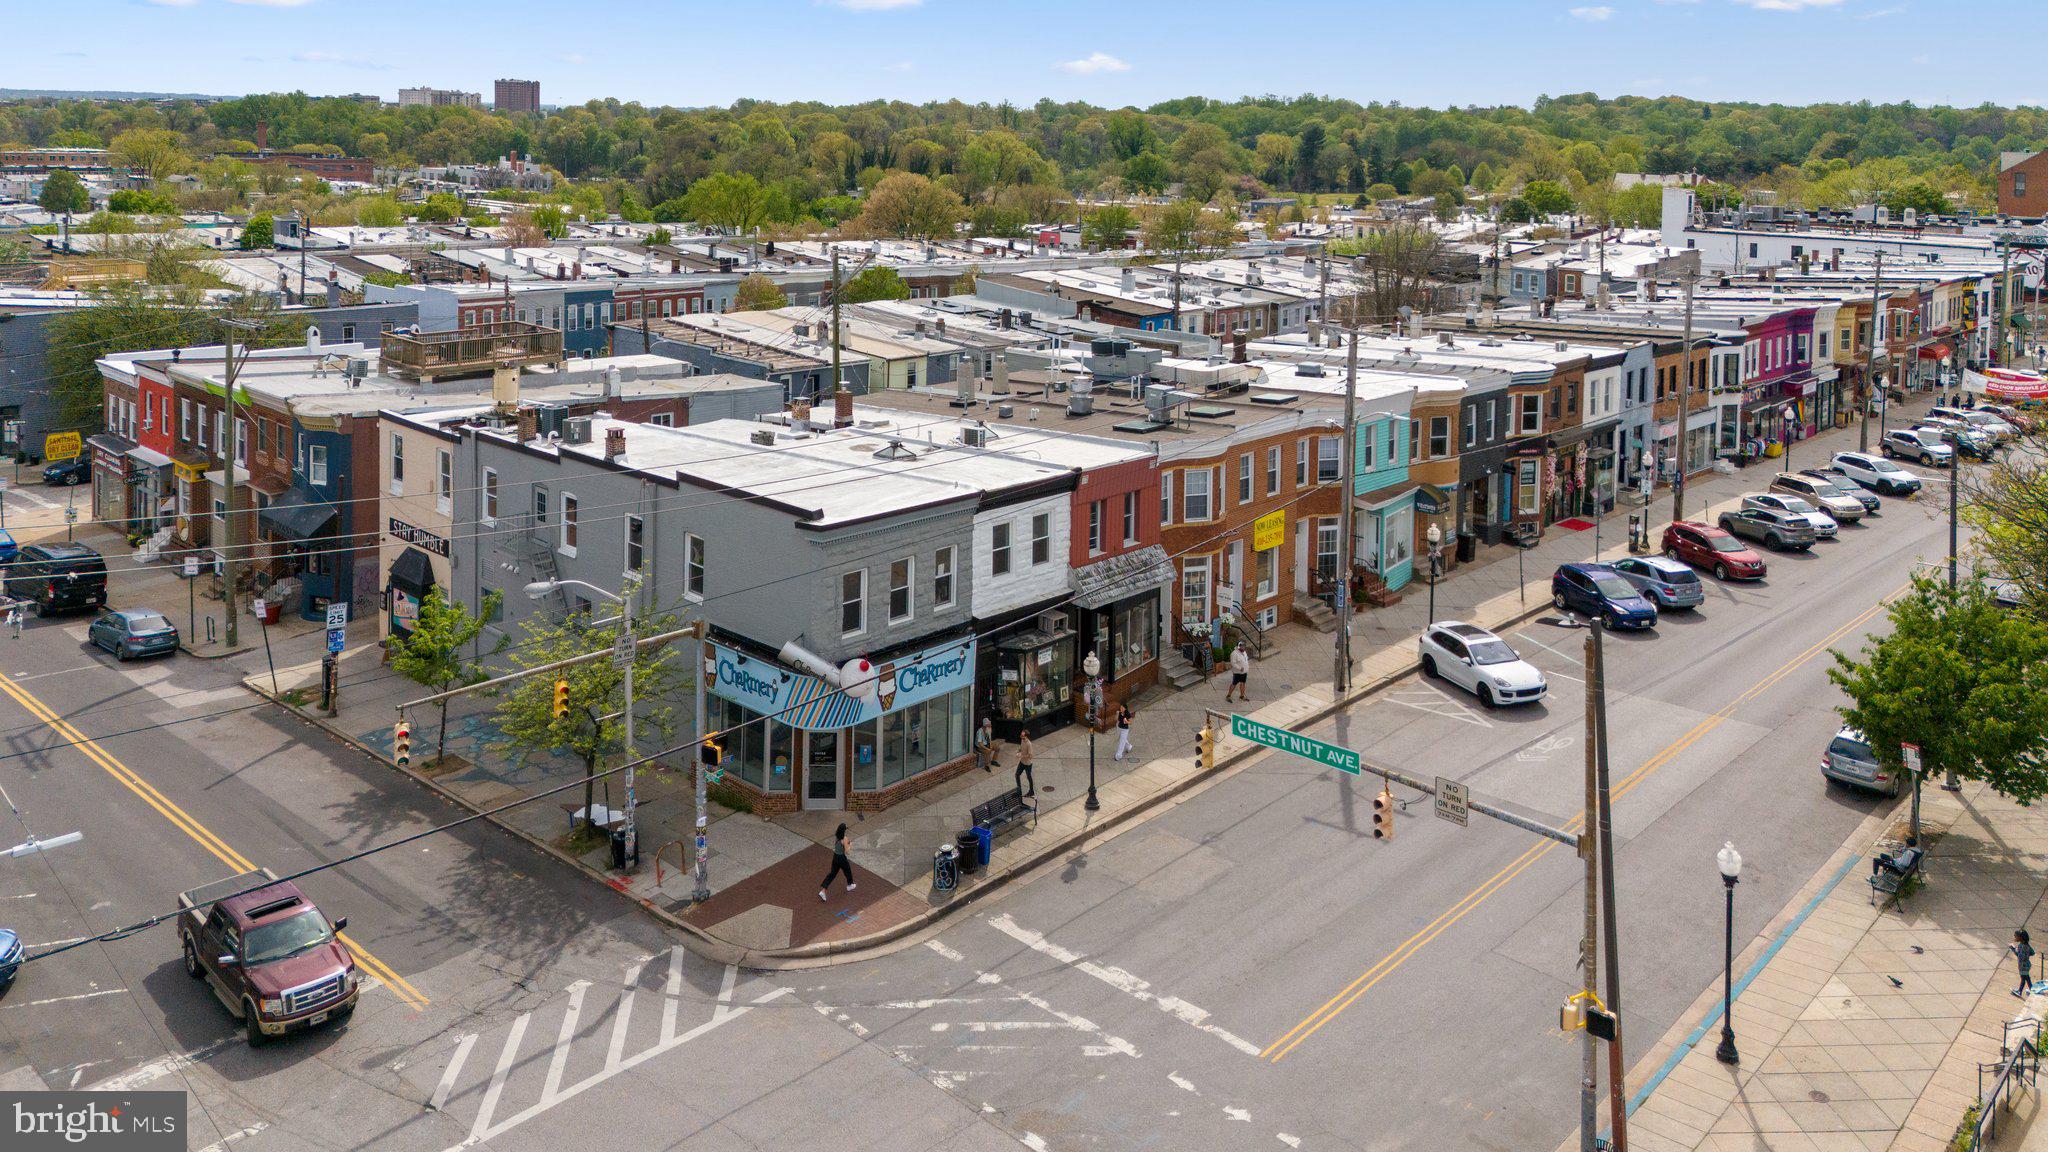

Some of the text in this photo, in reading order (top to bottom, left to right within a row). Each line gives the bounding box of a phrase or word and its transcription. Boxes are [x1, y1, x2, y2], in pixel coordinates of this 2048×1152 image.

[393, 521, 444, 554] STAY HUMBLE
[328, 614, 344, 625] 25
[621, 637, 631, 645] NO
[618, 644, 633, 652] TURN
[1237, 720, 1358, 770] CHESTNUT AVE.
[1446, 784, 1459, 793] NO
[1442, 792, 1462, 804] TURN
[1438, 799, 1466, 815] ON RED
